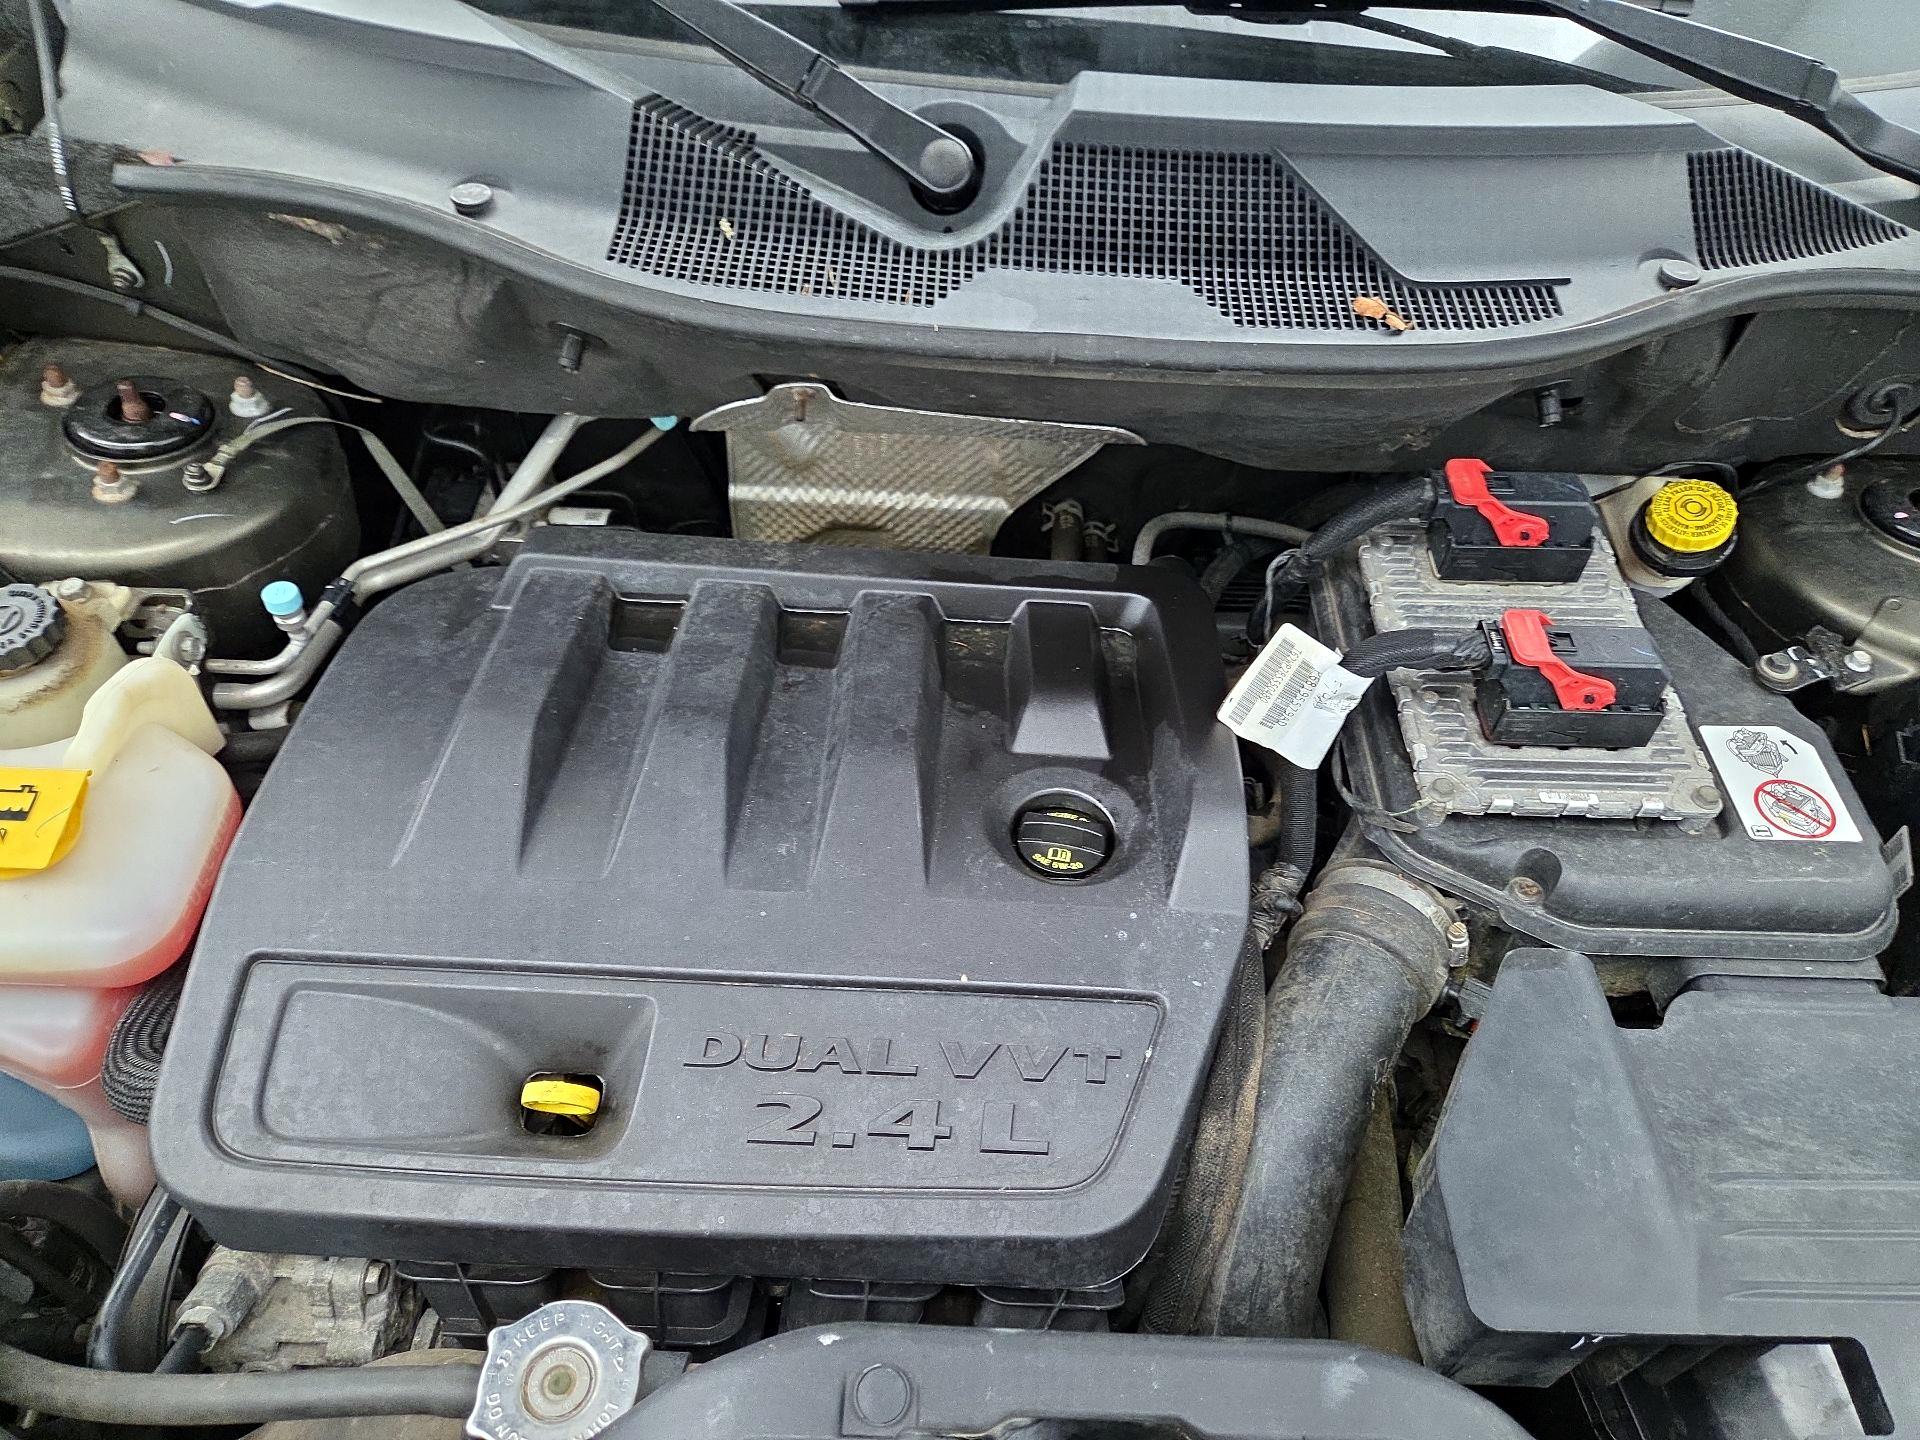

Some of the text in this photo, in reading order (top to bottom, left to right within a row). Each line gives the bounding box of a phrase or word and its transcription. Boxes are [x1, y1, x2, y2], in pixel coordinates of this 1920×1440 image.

[1032, 853, 1052, 866] SAE
[683, 1029, 1122, 1085] DUAL VVT
[513, 1312, 568, 1348] KEEP
